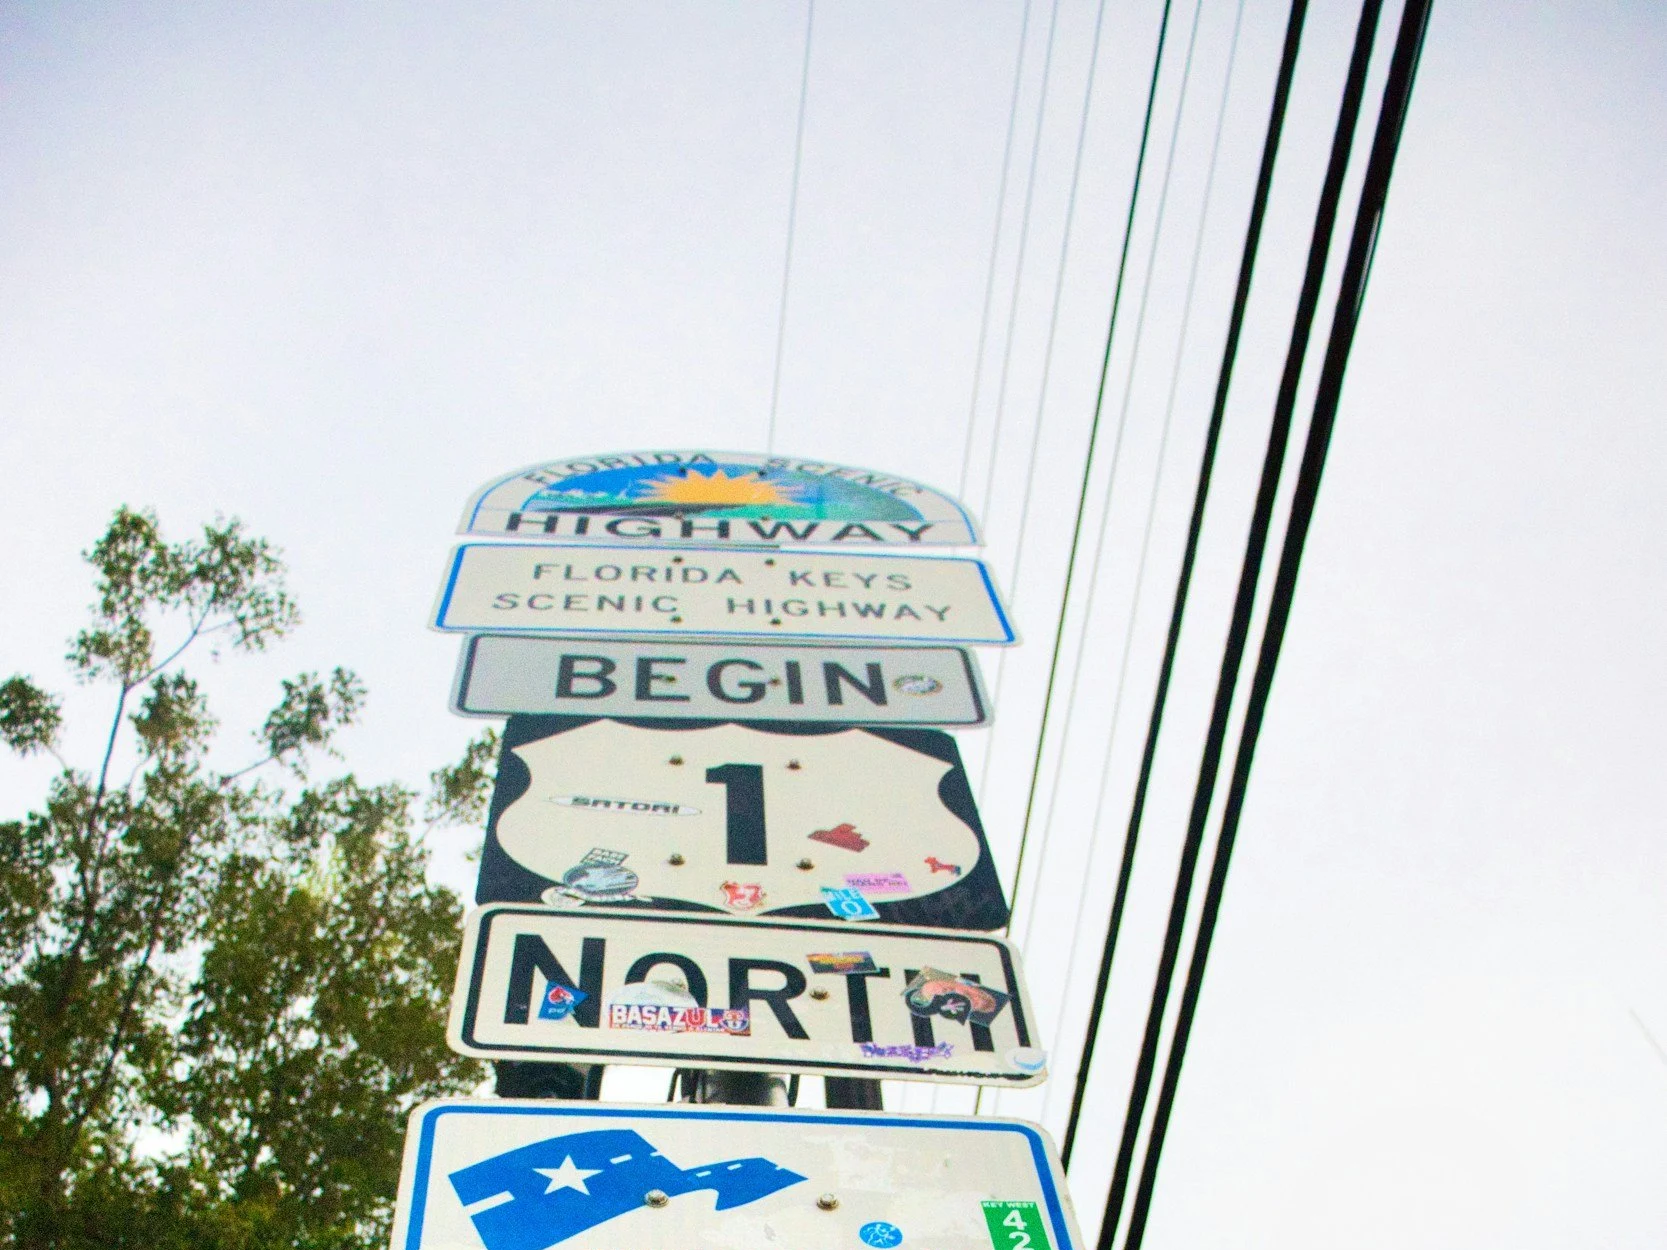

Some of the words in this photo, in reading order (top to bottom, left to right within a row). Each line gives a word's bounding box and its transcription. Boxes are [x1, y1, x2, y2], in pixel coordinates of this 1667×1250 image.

[524, 453, 716, 484] FLORIDA
[764, 456, 923, 494] SCENIC
[505, 511, 934, 541] HIGHWAY
[532, 562, 743, 584] FLORIDA
[788, 569, 913, 591] KEYS
[491, 592, 678, 613] SCENIC
[726, 597, 952, 621] HIGHWAY
[555, 654, 889, 707] BEGIN
[705, 763, 768, 867] 1
